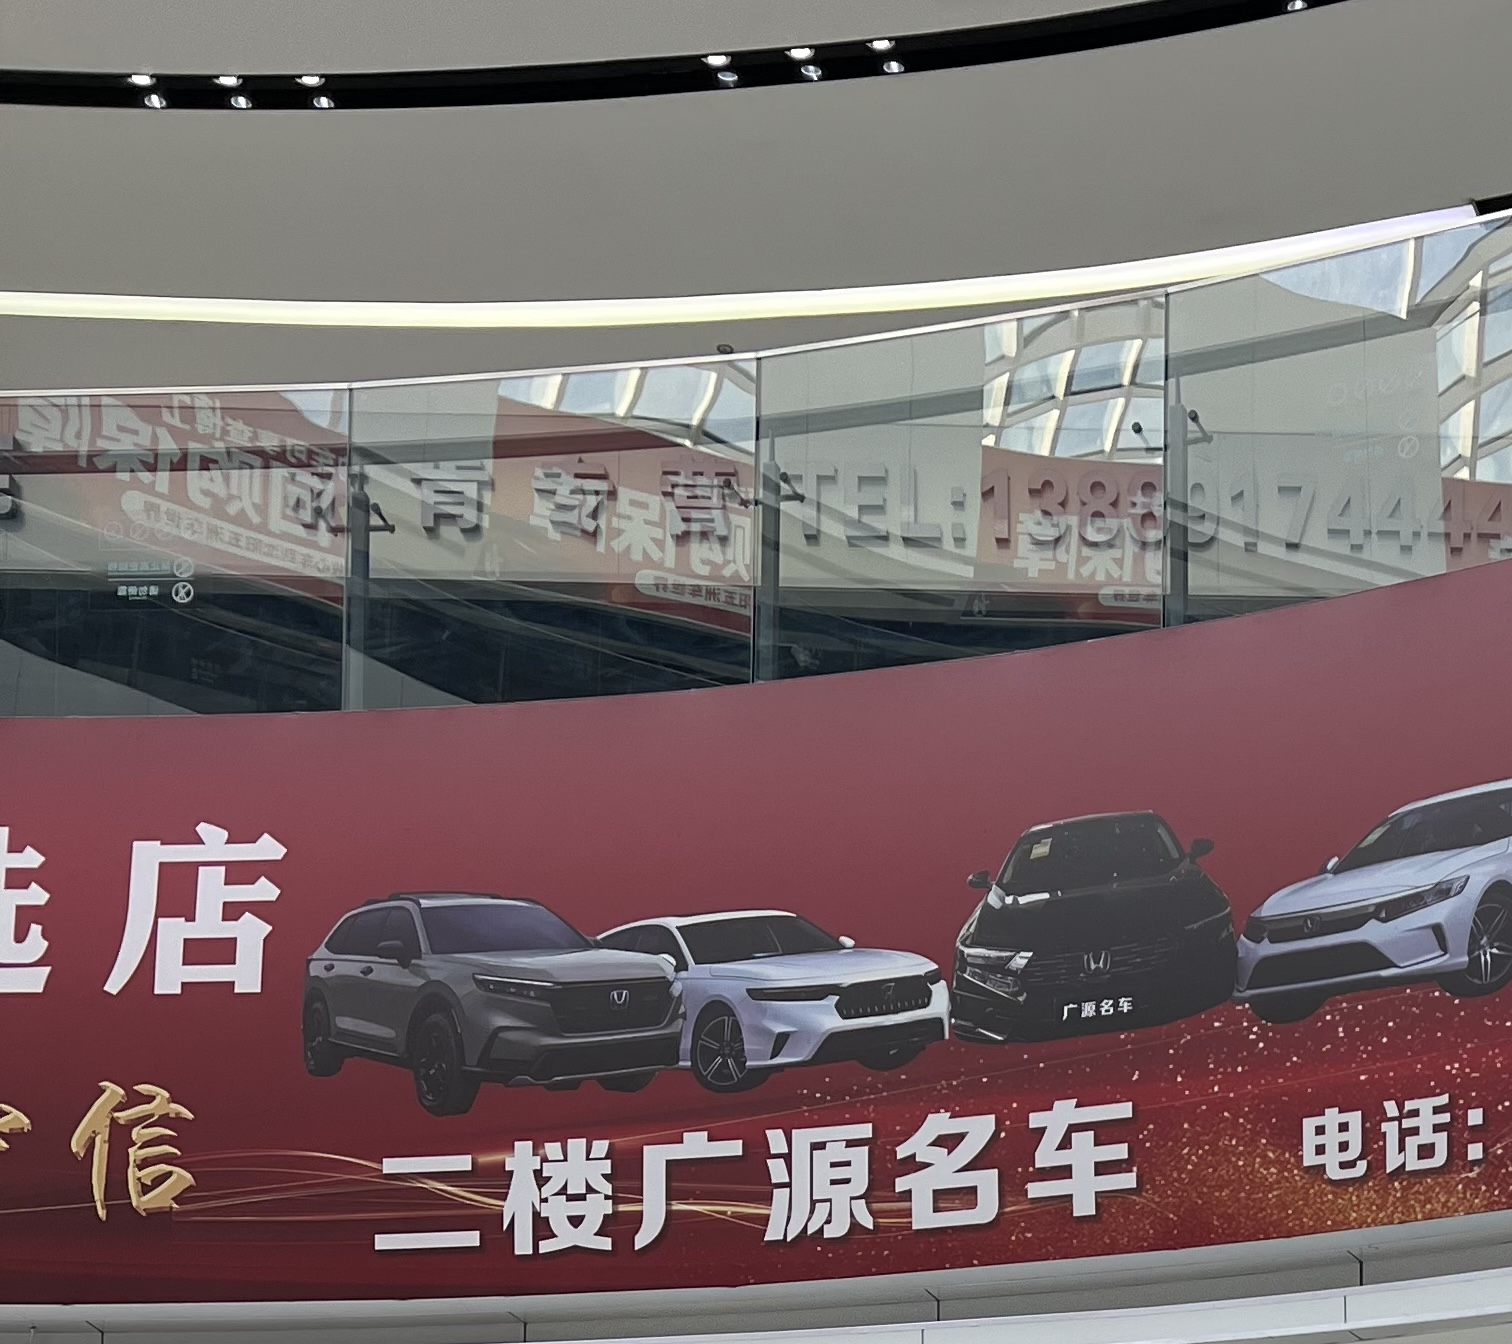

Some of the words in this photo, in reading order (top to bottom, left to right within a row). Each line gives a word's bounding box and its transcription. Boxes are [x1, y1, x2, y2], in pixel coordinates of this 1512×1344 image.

[0, 822, 288, 996] 店
[1061, 996, 1134, 1022] 广源名车
[0, 1081, 197, 1222] 信
[374, 1098, 1138, 1256] 二楼广源名车
